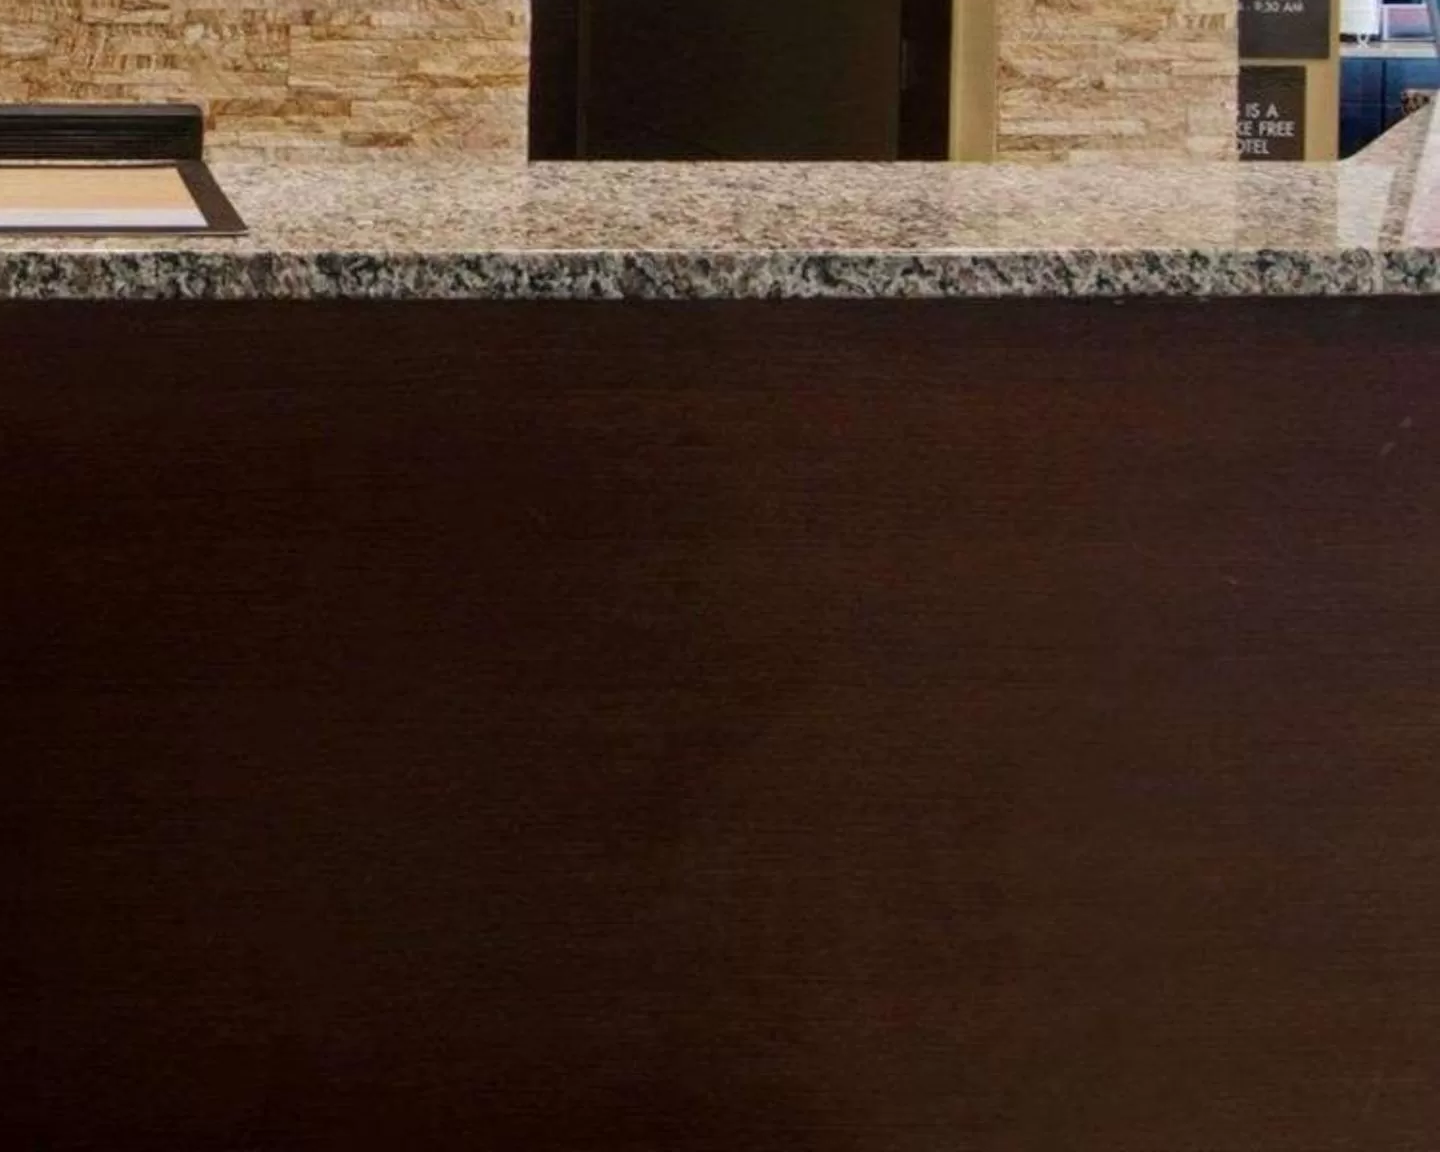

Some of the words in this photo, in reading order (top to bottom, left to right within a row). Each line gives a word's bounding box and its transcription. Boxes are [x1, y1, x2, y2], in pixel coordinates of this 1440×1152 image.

[1245, 102, 1260, 118] IS
[1266, 102, 1279, 118] A
[1259, 120, 1295, 137] FREE
